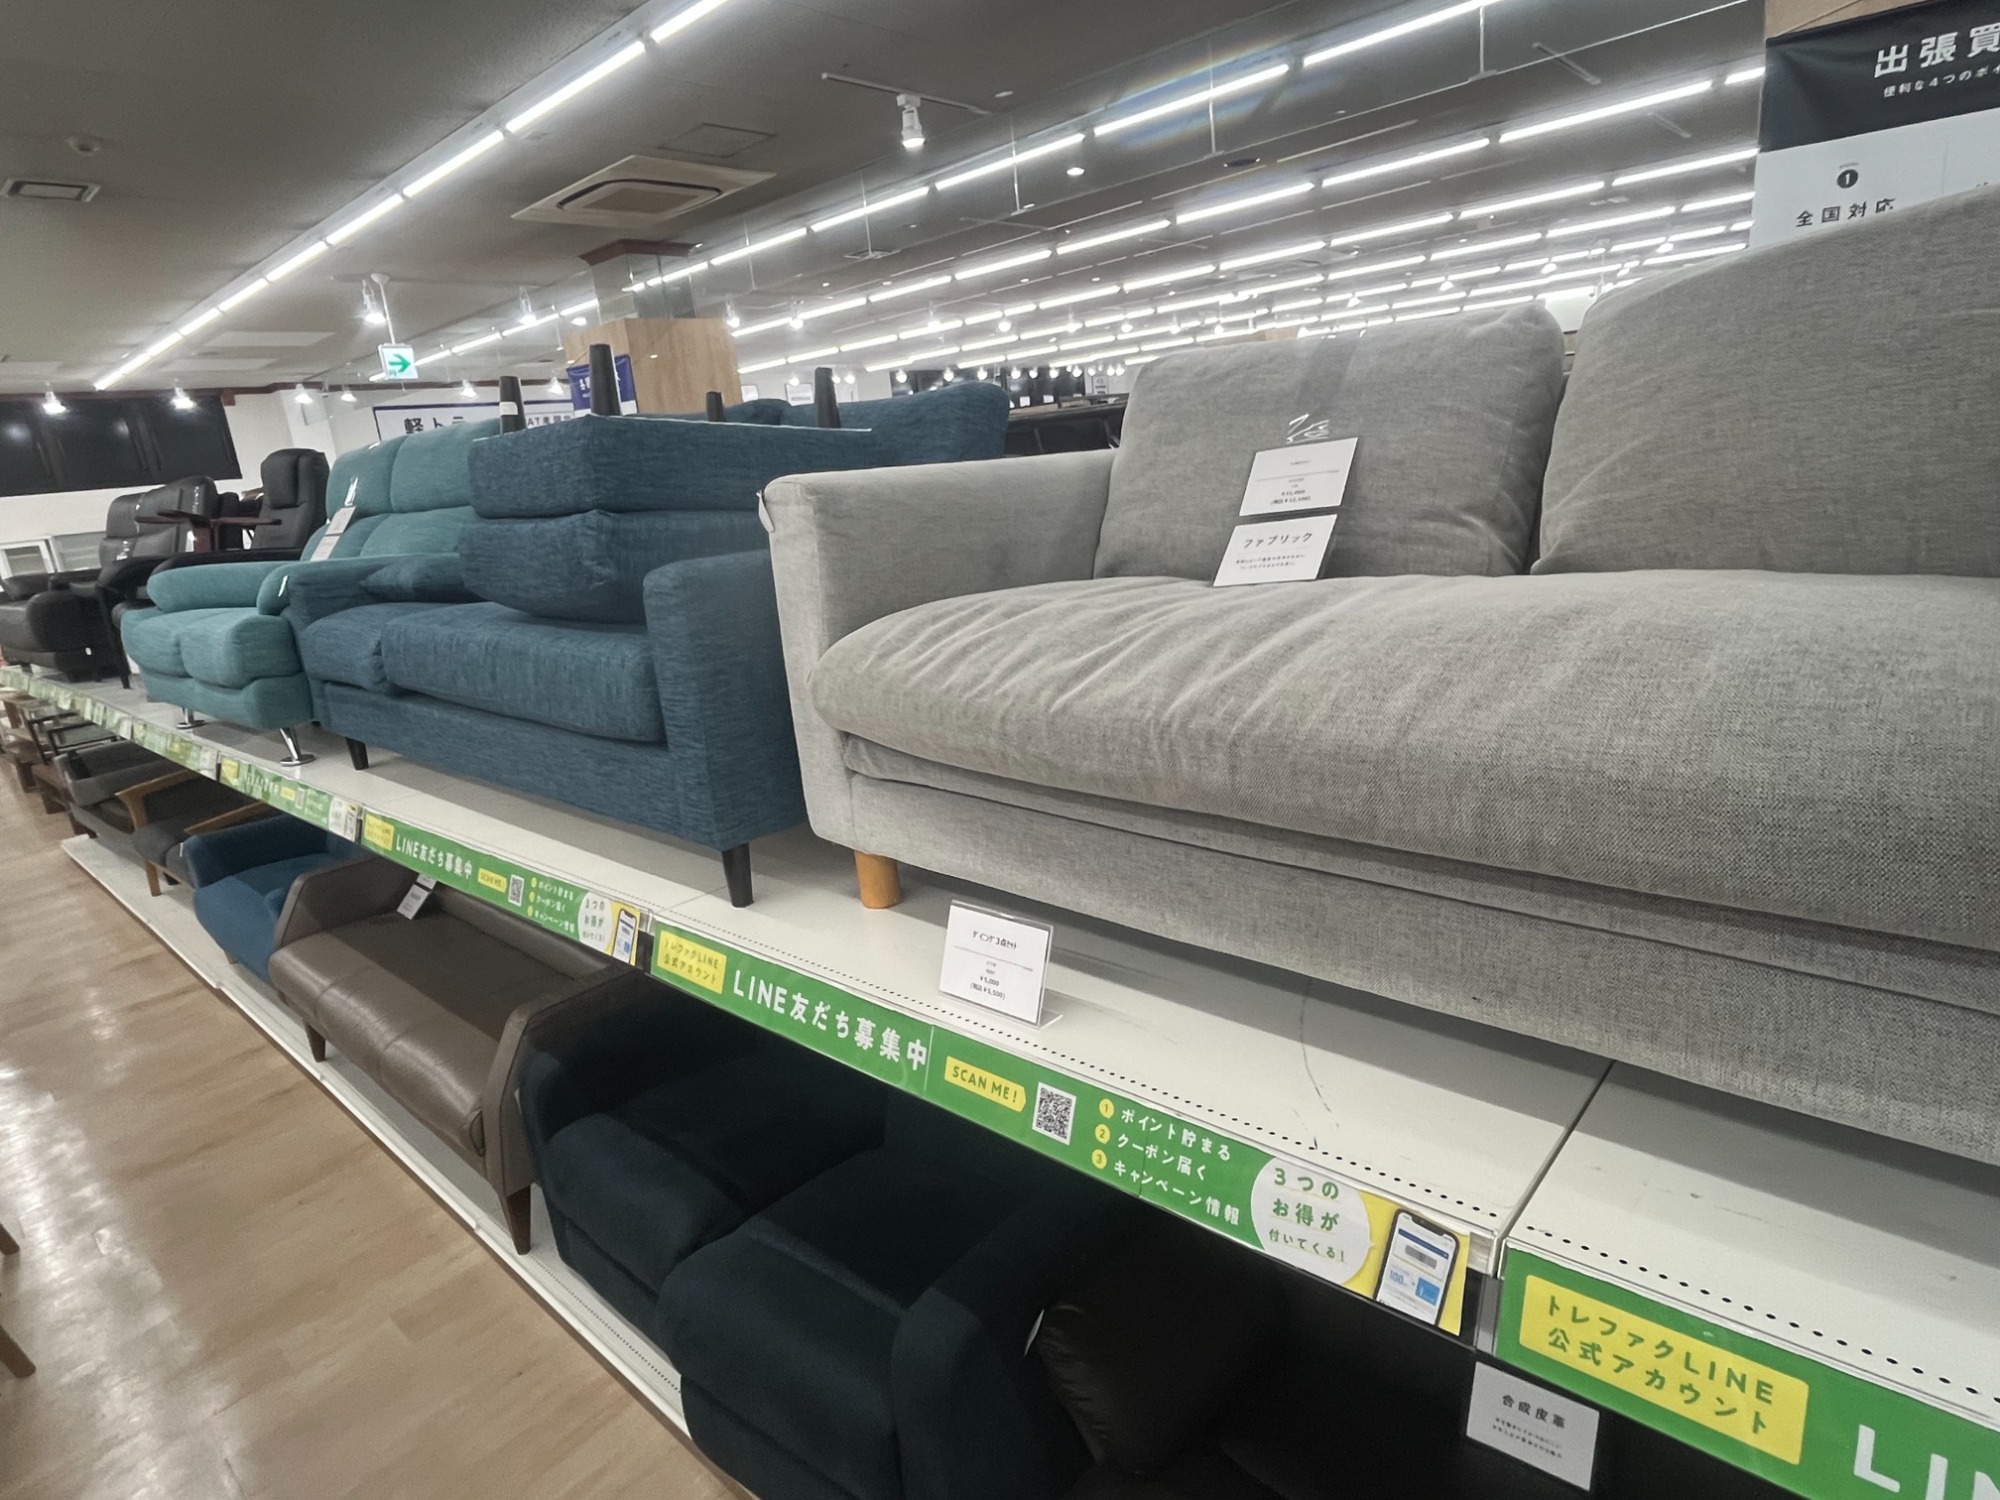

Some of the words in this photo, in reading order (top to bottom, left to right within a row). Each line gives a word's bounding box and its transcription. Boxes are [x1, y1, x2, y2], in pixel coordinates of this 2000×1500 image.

[1874, 22, 2000, 78] 出張買
[1796, 198, 1896, 228] 全国対応
[1243, 532, 1313, 549] ファブリック
[733, 969, 928, 1071] LINE友だち募集中
[952, 1066, 987, 1090] SCAN
[1121, 1108, 1231, 1161] ポイント貯まる
[1118, 1134, 1206, 1180] クーポン届く
[1114, 1160, 1240, 1226] キャンペーン情報
[1273, 1167, 1340, 1200] 3つの
[1273, 1198, 1340, 1232] お得が
[1268, 1228, 1345, 1262] 付いてくる!
[1549, 1295, 1775, 1403] トレファクLINE
[1548, 1328, 1768, 1435] 公式アカウント
[1502, 1394, 1566, 1429] 合成皮革
